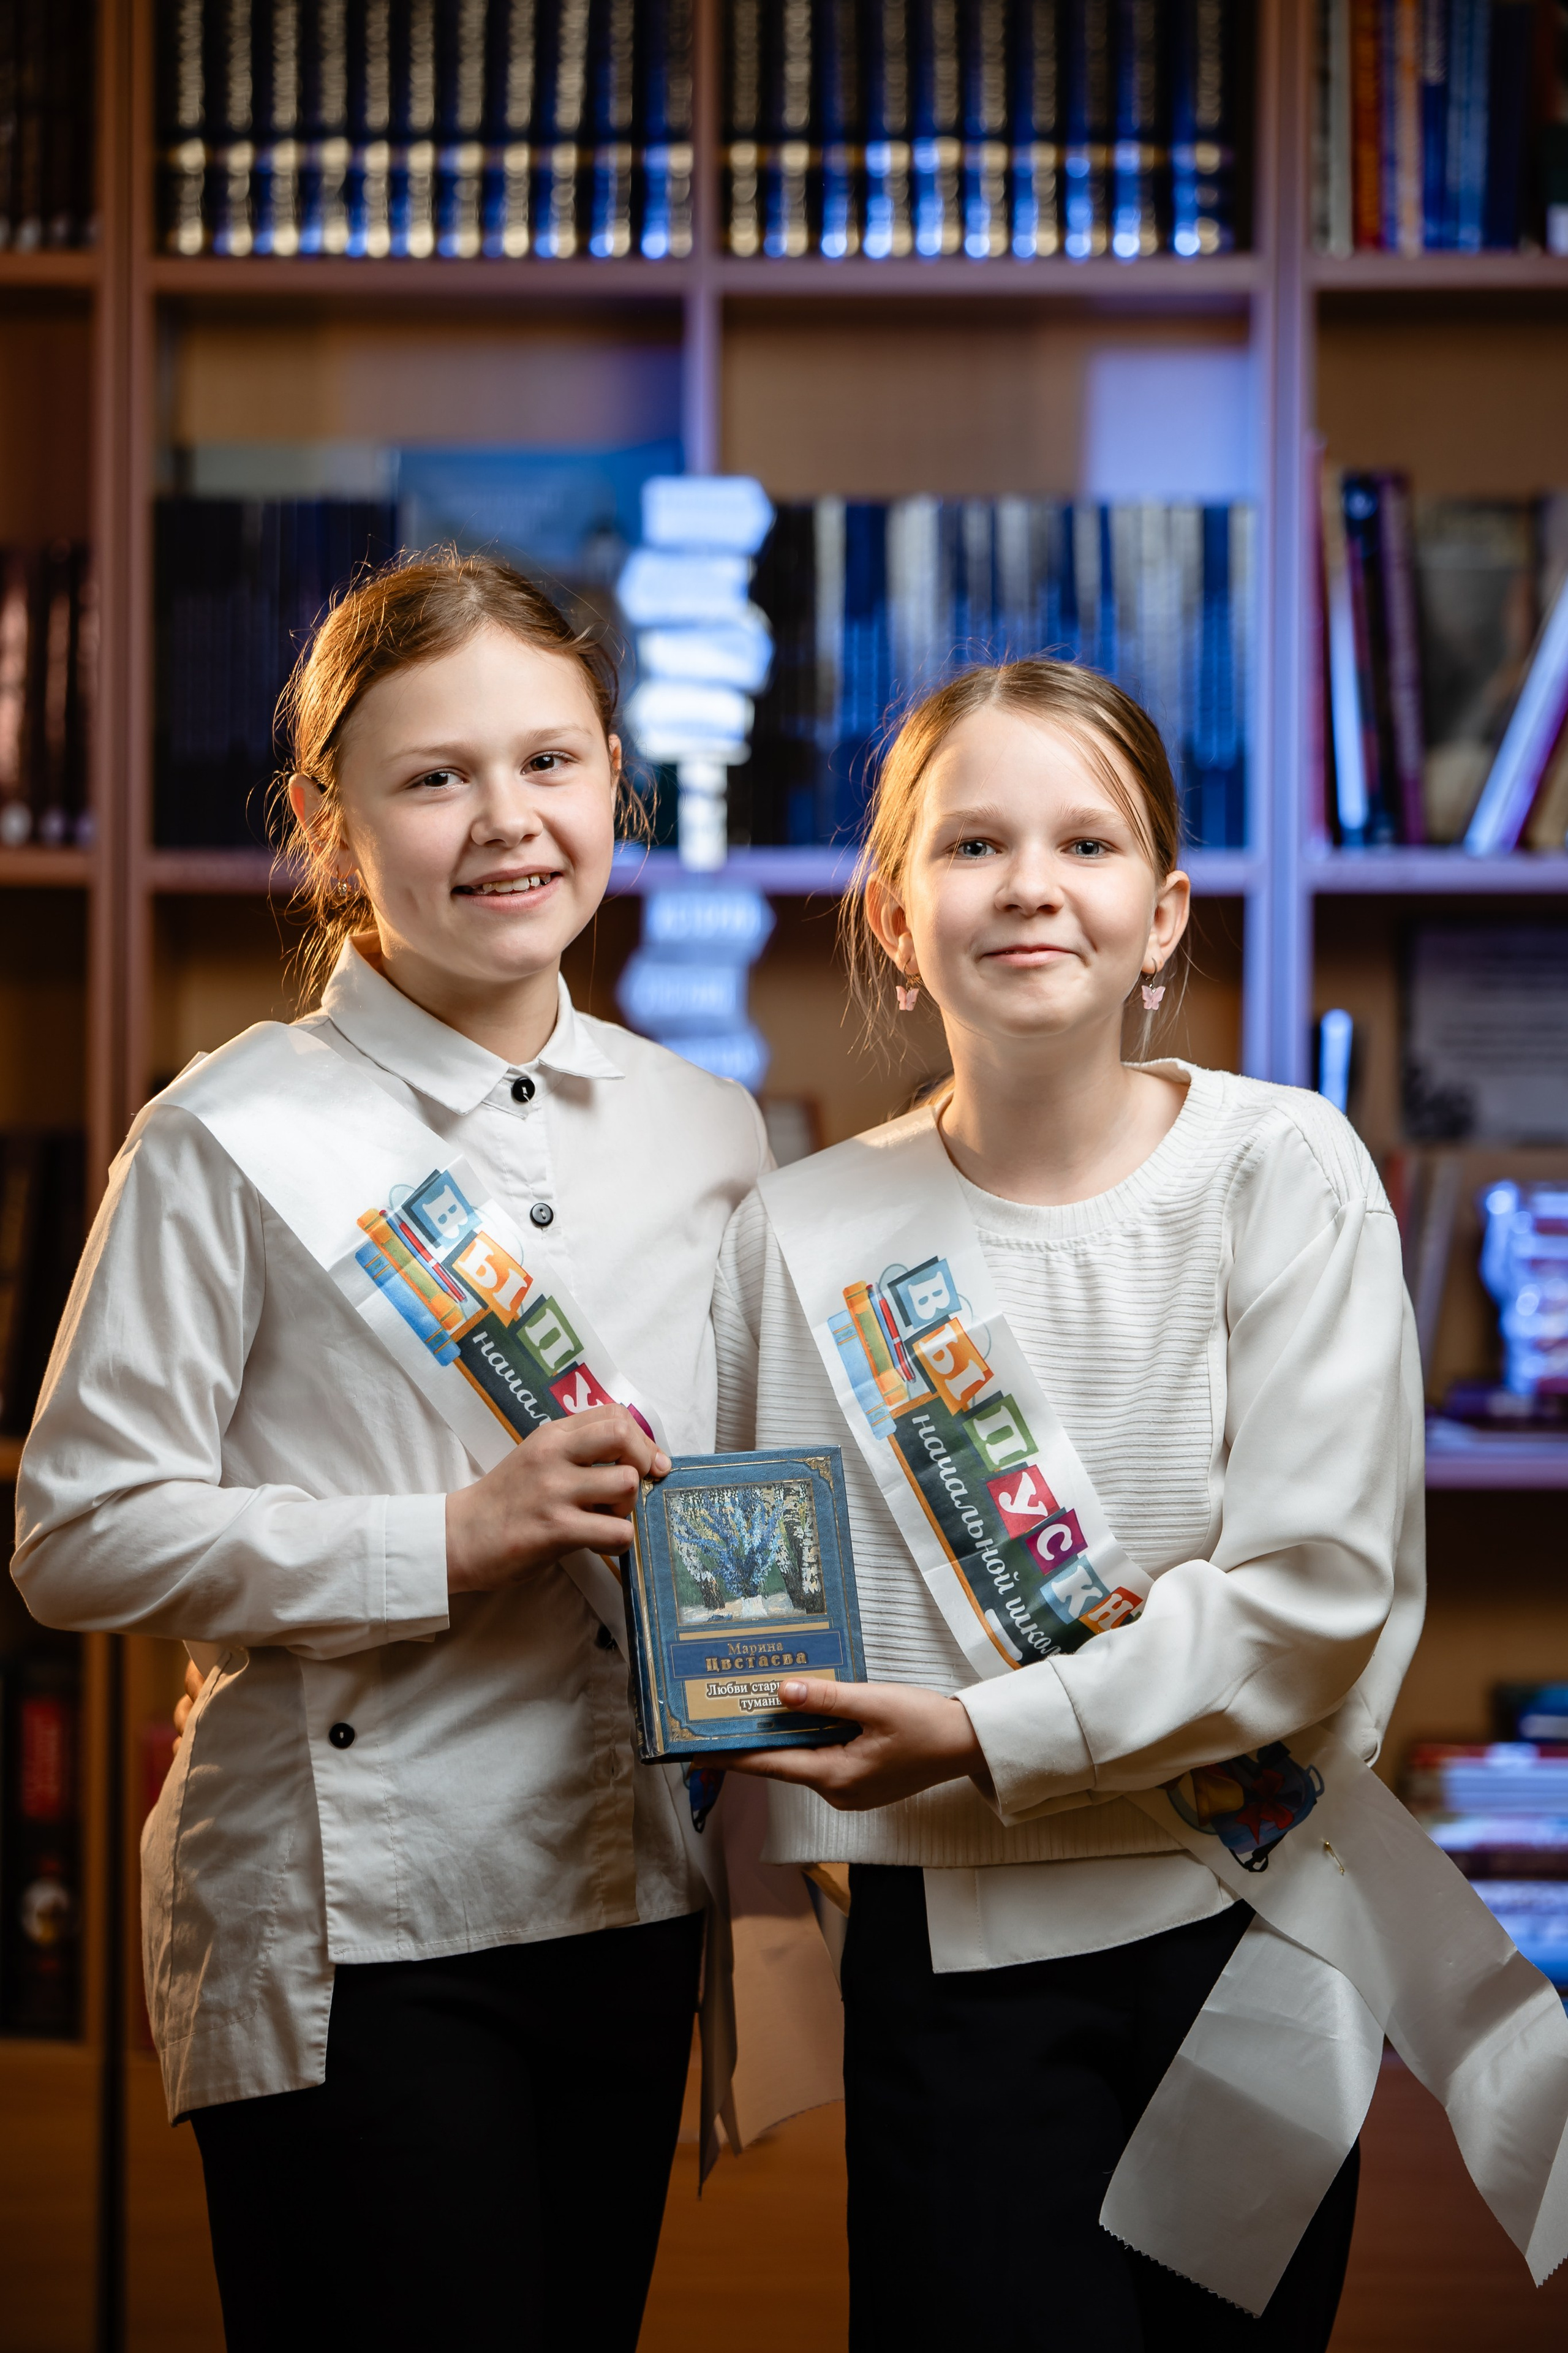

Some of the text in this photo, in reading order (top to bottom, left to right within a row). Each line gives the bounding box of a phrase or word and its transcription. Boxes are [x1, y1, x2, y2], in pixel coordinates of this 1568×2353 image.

[423, 1184, 603, 1414] ВЫПУ
[473, 1331, 552, 1427] начал
[907, 1271, 1133, 1630] ВЫПУСКН
[911, 1414, 1061, 1656] начальной школ
[706, 1652, 807, 1672] Цветаева
[707, 1683, 748, 1696] Любви
[727, 1642, 784, 1656] Марина
